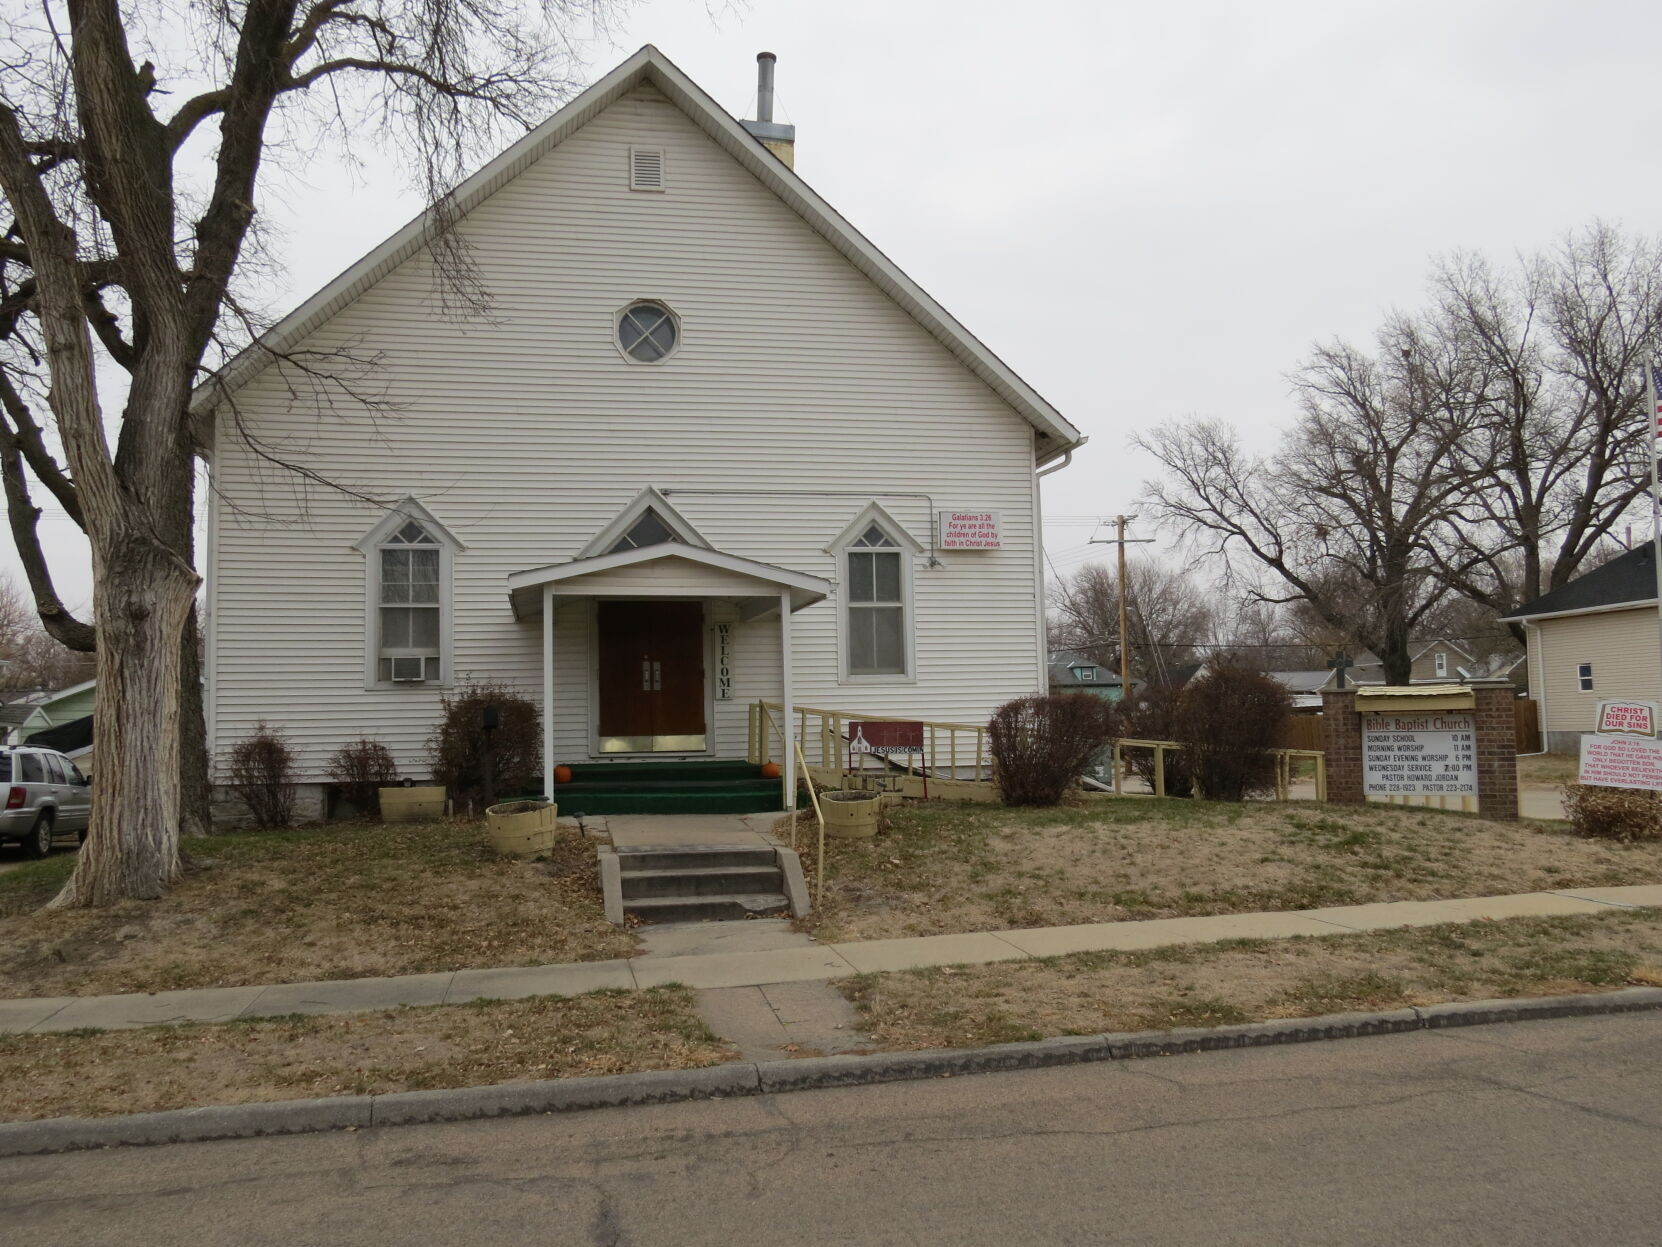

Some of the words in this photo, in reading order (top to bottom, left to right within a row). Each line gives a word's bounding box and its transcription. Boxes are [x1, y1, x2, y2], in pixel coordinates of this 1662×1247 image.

[719, 624, 731, 698] WELCOME
[1611, 706, 1644, 715] CHRIST
[1367, 718, 1390, 730] Bible
[1395, 718, 1428, 731] Baptist
[1433, 717, 1470, 729] Church
